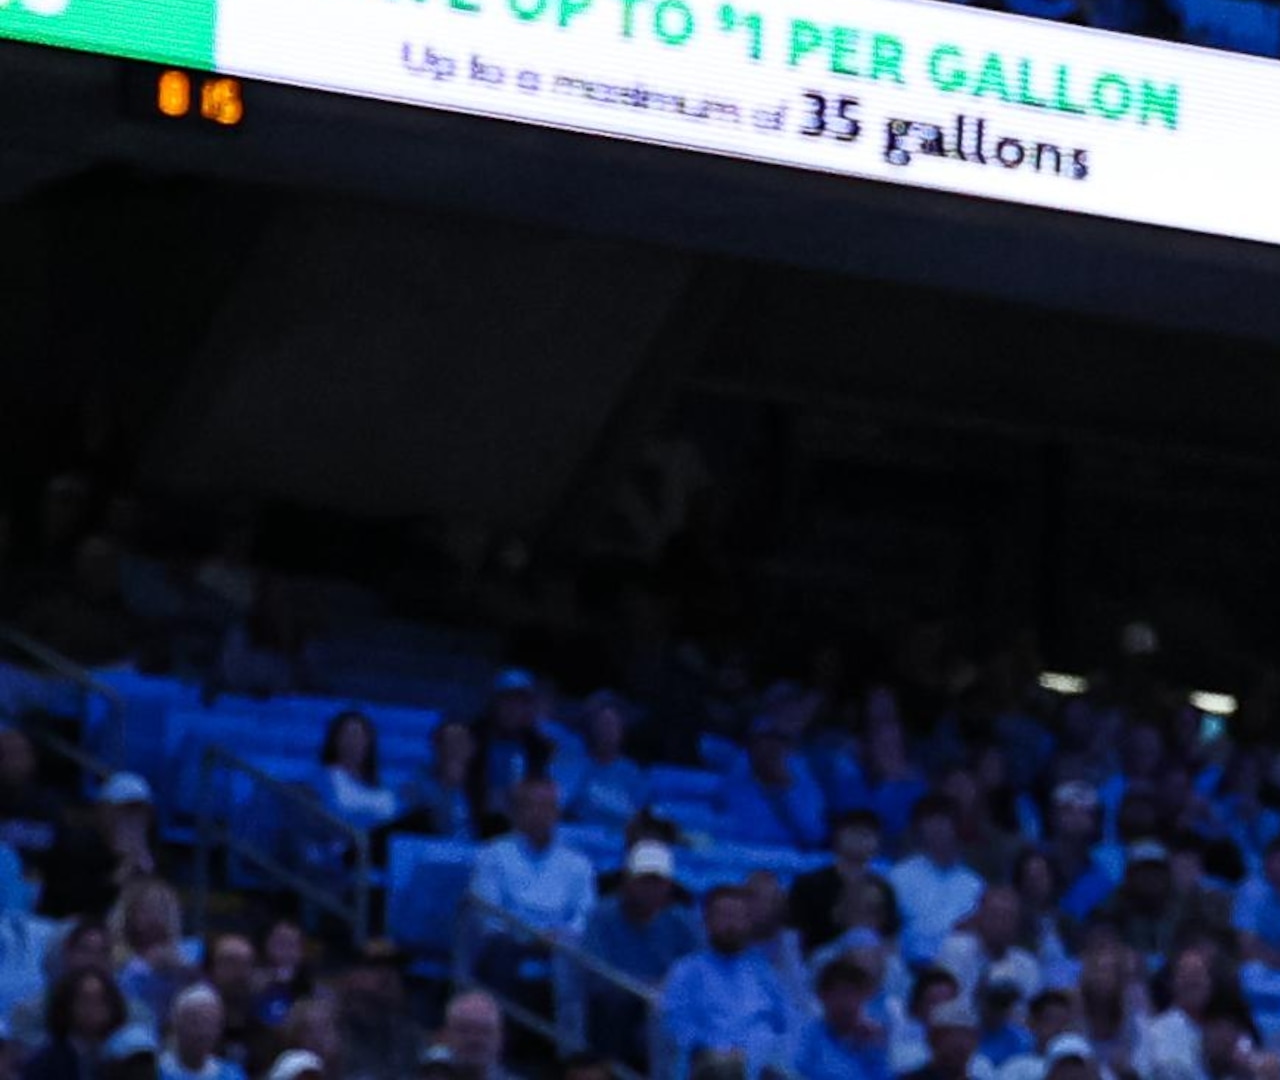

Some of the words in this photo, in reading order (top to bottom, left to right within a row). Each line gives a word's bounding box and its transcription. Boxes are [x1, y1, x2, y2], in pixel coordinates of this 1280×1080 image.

[401, 41, 456, 81] Up
[469, 52, 505, 84] to
[516, 69, 541, 92] a
[801, 89, 861, 141] 35
[885, 113, 1089, 180] gallons
[789, 18, 905, 84] PER
[928, 44, 1179, 130] GALLON
